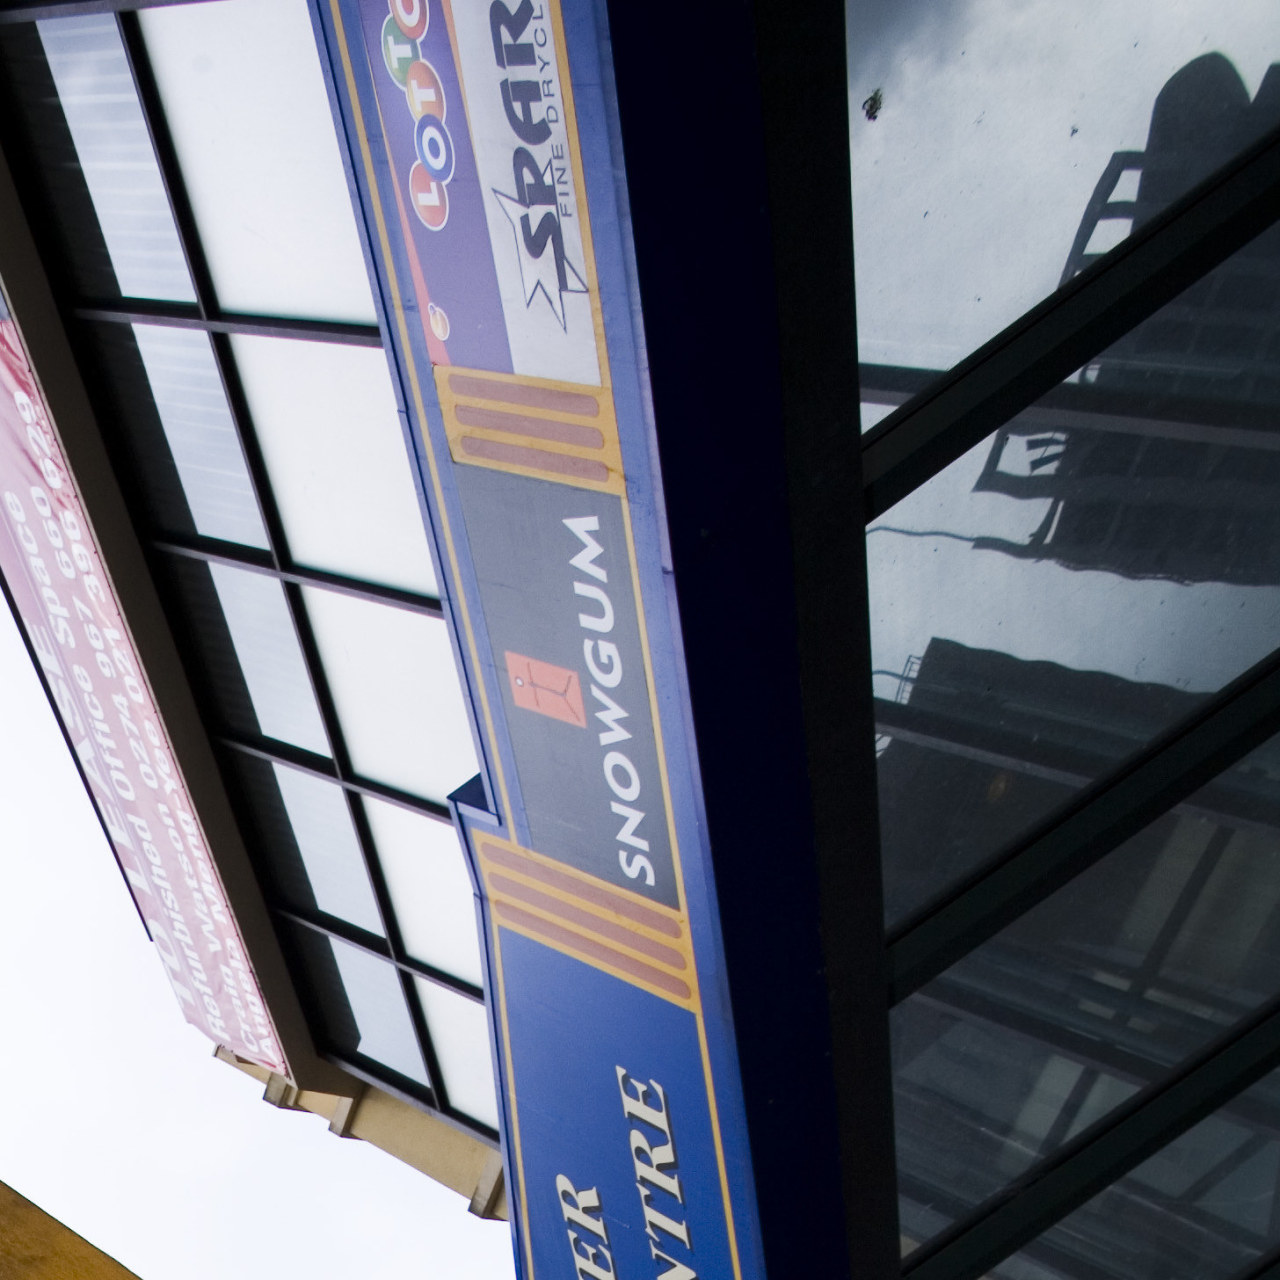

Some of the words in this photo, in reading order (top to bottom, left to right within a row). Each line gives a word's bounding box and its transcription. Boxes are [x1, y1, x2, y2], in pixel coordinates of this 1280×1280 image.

[551, 143, 572, 218] FINE
[14, 389, 62, 490] 629
[4, 491, 76, 649] Space
[30, 486, 76, 580] 660
[59, 509, 106, 603] 396
[72, 595, 117, 679] 967
[103, 625, 144, 704] 021
[73, 663, 136, 801] Office
[111, 692, 159, 790] 0274
[562, 515, 655, 886] SNOWGUM
[24, 617, 153, 896] LEASE
[157, 802, 222, 953] Watson
[126, 812, 231, 1043] Refurbished
[148, 918, 195, 1009] TO
[220, 963, 260, 1053] Craig
[225, 936, 280, 1064] Angela
